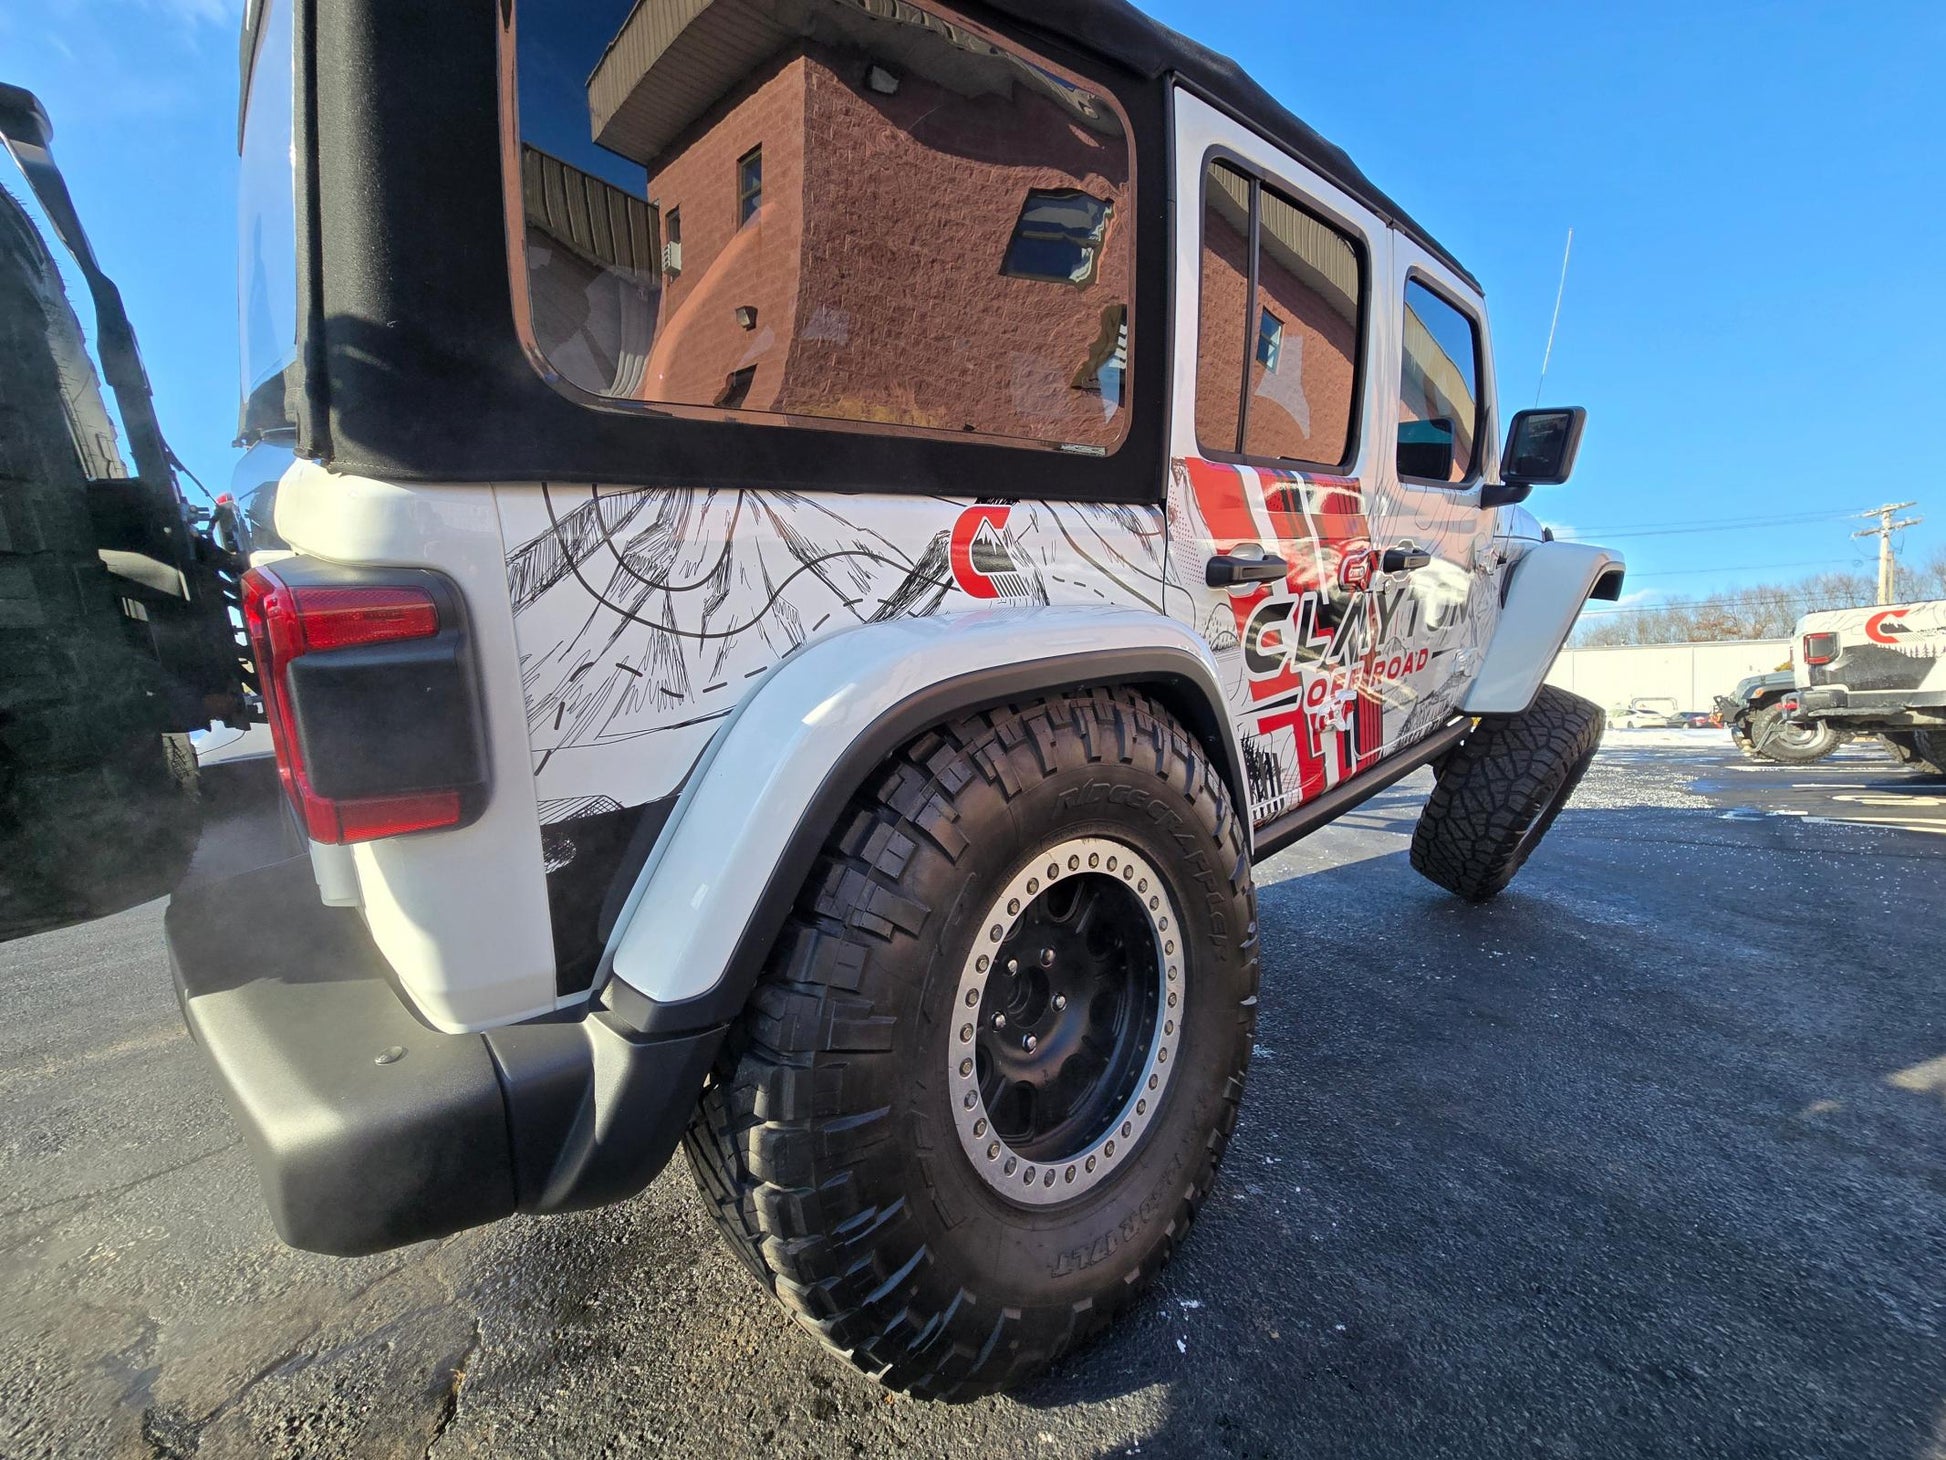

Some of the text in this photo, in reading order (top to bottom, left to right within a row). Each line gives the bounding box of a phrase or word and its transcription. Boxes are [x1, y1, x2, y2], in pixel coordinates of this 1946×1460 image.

[1244, 581, 1473, 674] CLAYTON
[1307, 648, 1429, 708] OFF ROAD
[1054, 778, 1151, 812] RIDGE
